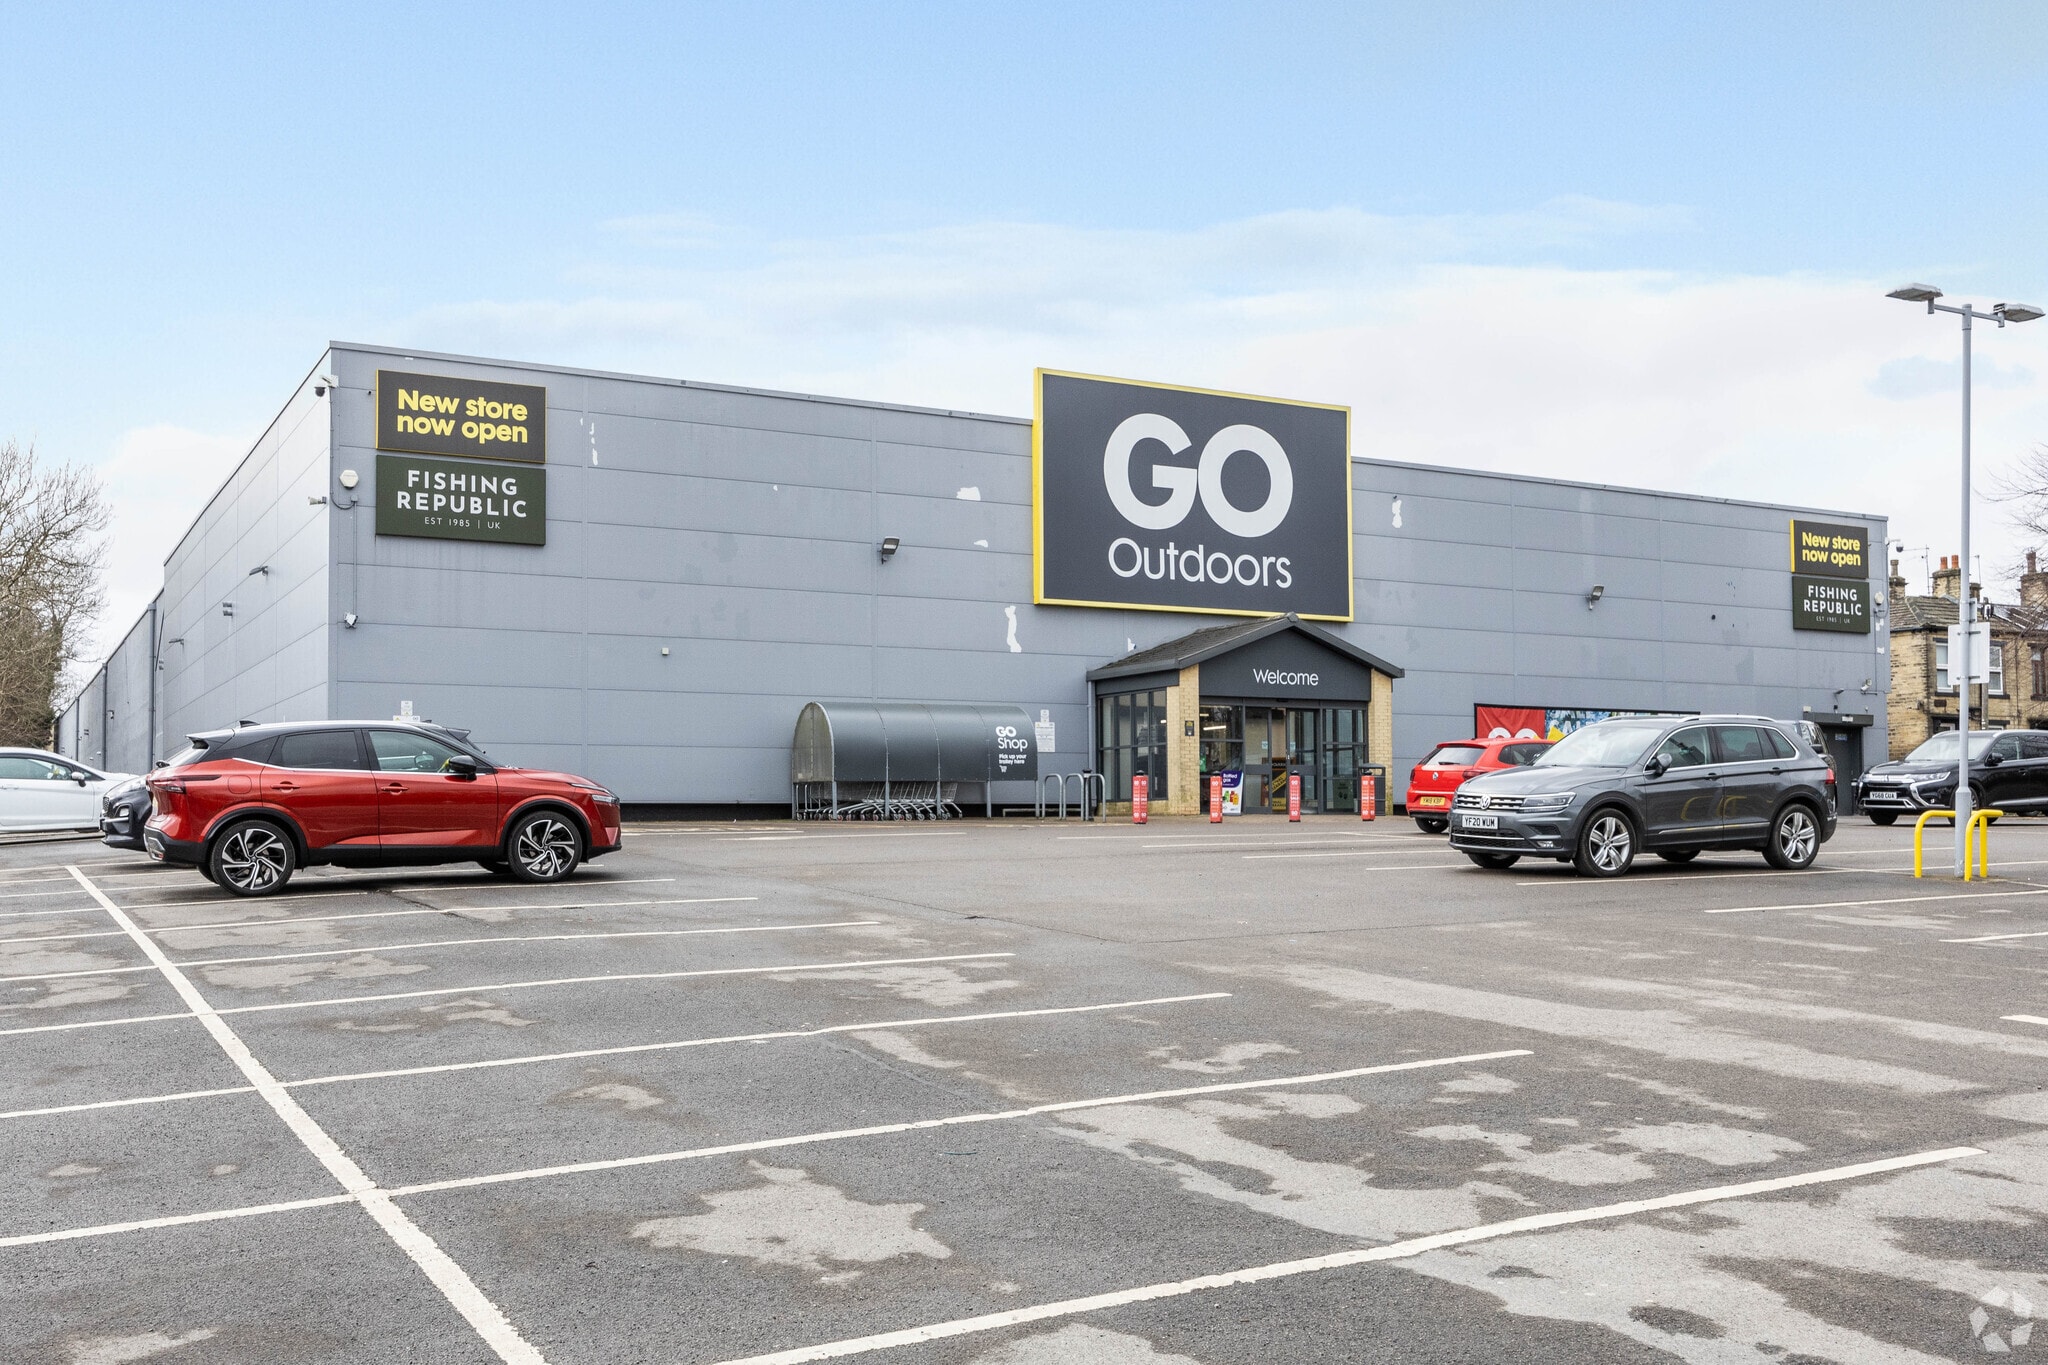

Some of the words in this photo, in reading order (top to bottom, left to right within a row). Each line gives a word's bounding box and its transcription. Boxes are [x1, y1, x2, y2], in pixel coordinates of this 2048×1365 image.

[398, 388, 460, 414] New
[465, 397, 528, 421] store
[397, 414, 456, 436] now
[461, 421, 528, 444] open
[408, 470, 518, 496] FISHING
[1103, 412, 1293, 538] GO
[397, 491, 527, 518] REPUBLIC
[424, 516, 442, 525] EST
[448, 518, 470, 527] 1985
[488, 521, 501, 530] UK
[1802, 532, 1830, 549] New
[1832, 536, 1860, 552] store
[1108, 538, 1292, 588] Outdoors
[1802, 549, 1828, 562] now
[1831, 552, 1861, 567] open
[1808, 585, 1858, 601] FISHING
[1804, 600, 1862, 616] REPUBLIC
[1253, 668, 1319, 686] Welcome
[996, 726, 1016, 737] GO
[998, 738, 1028, 752] Shop
[1465, 817, 1480, 826] YF20
[1482, 818, 1495, 827] WUM
